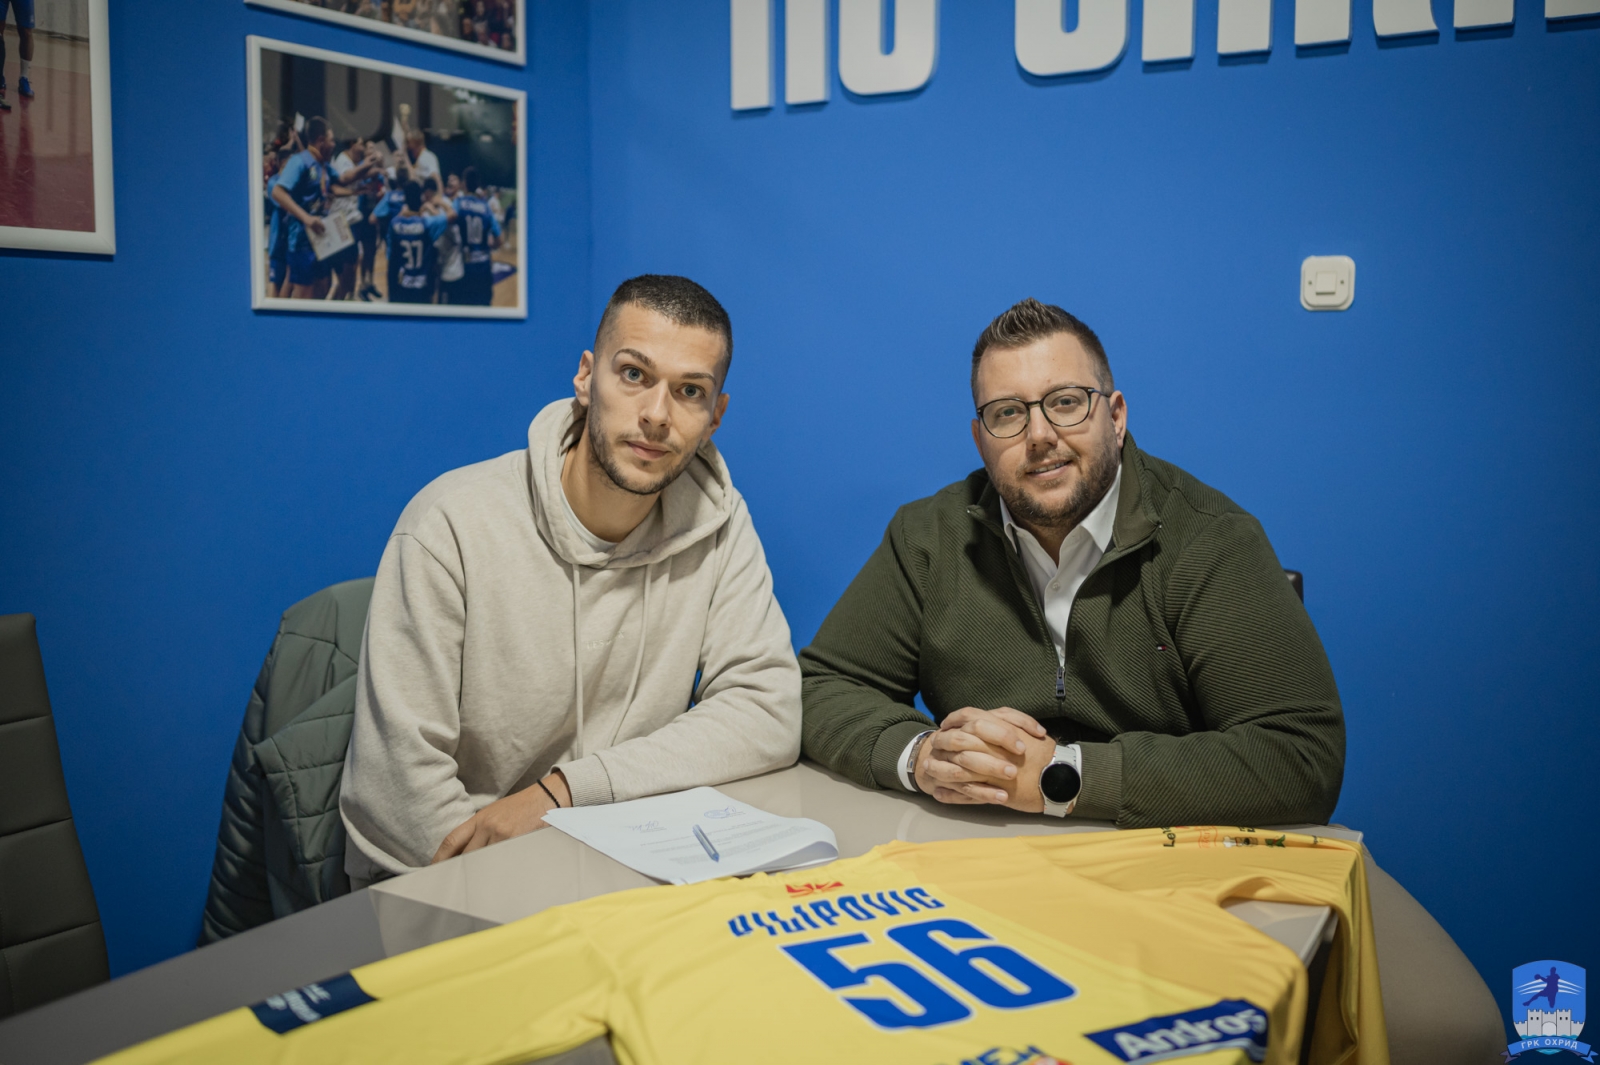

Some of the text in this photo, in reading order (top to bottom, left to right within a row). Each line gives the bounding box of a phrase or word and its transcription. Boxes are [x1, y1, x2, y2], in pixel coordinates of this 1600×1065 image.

[400, 239, 424, 270] 37
[778, 917, 1078, 1030] 56
[1113, 1008, 1267, 1061] Andros
